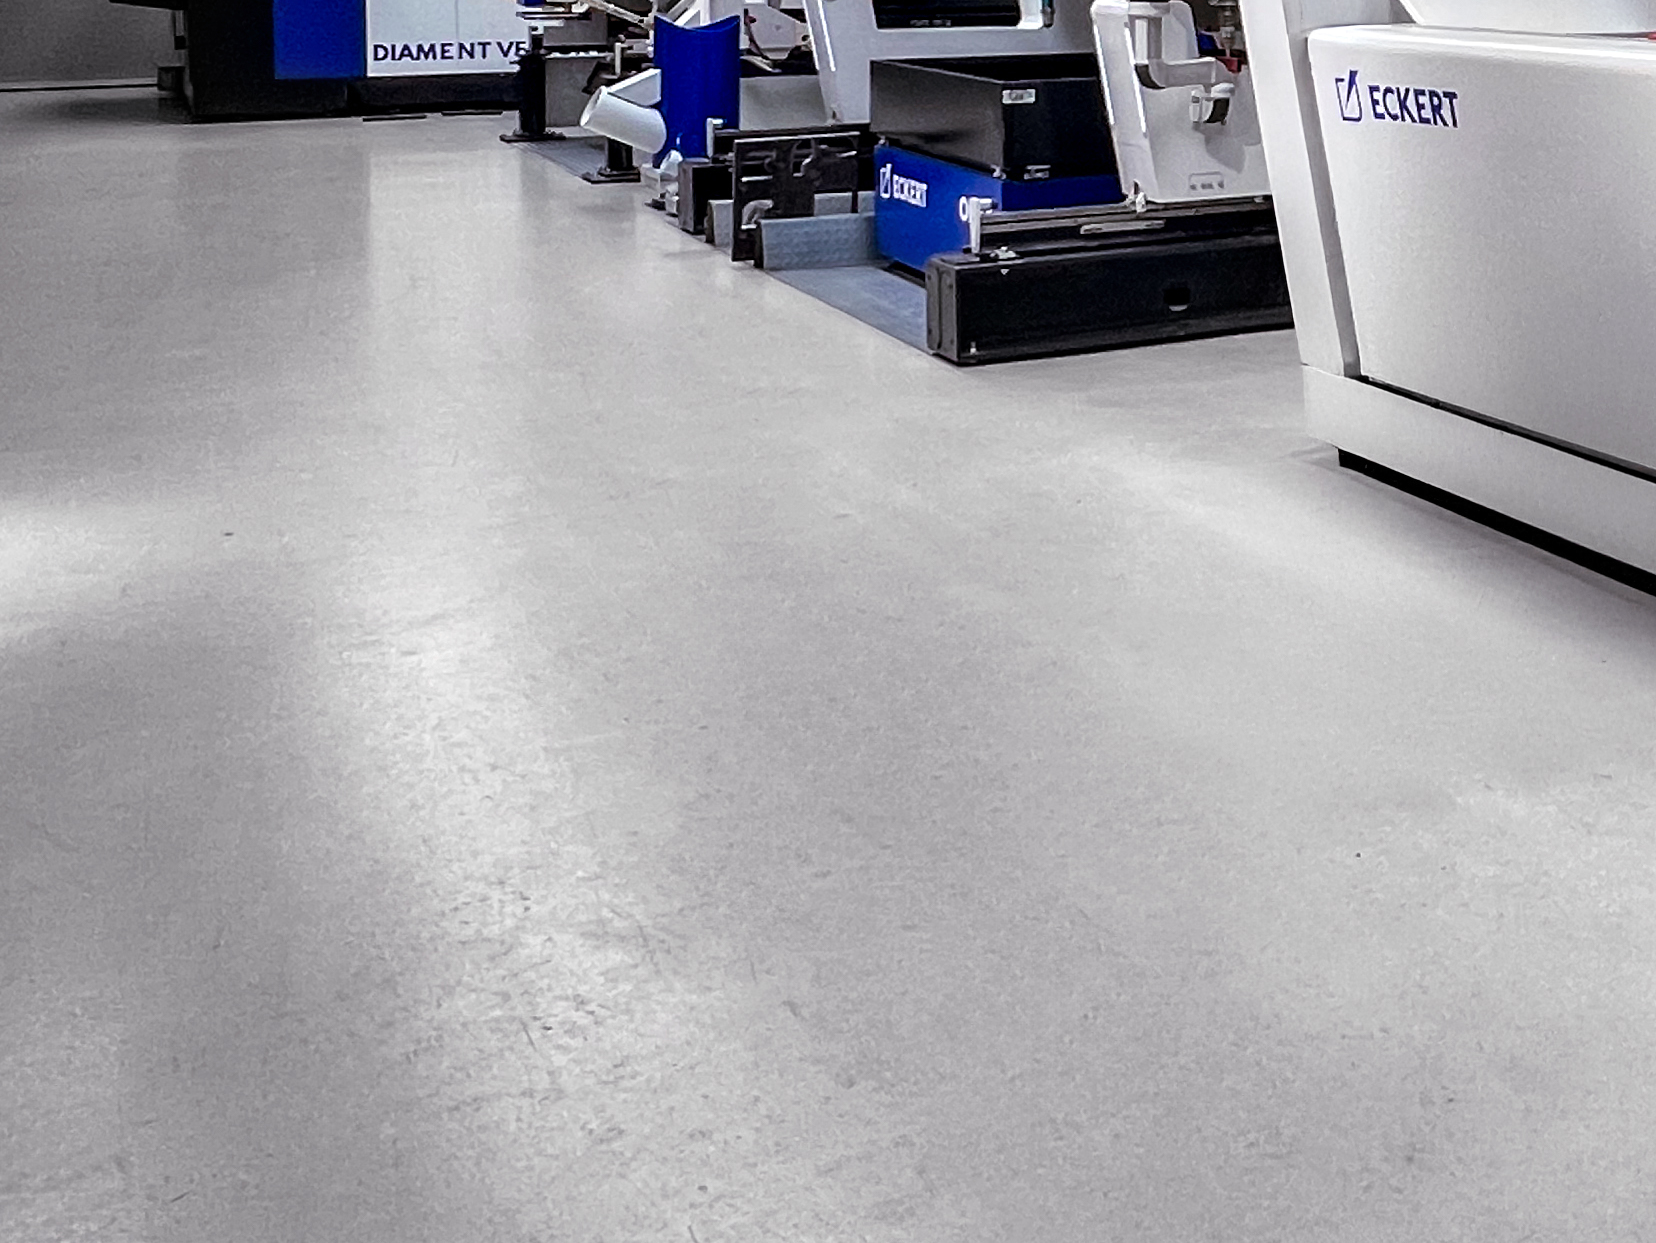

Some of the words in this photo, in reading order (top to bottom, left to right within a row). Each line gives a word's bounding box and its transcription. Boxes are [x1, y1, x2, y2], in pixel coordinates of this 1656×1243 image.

[373, 42, 491, 61] DIAMENT
[1367, 84, 1458, 128] ECKERT
[892, 173, 928, 208] ECKERT
